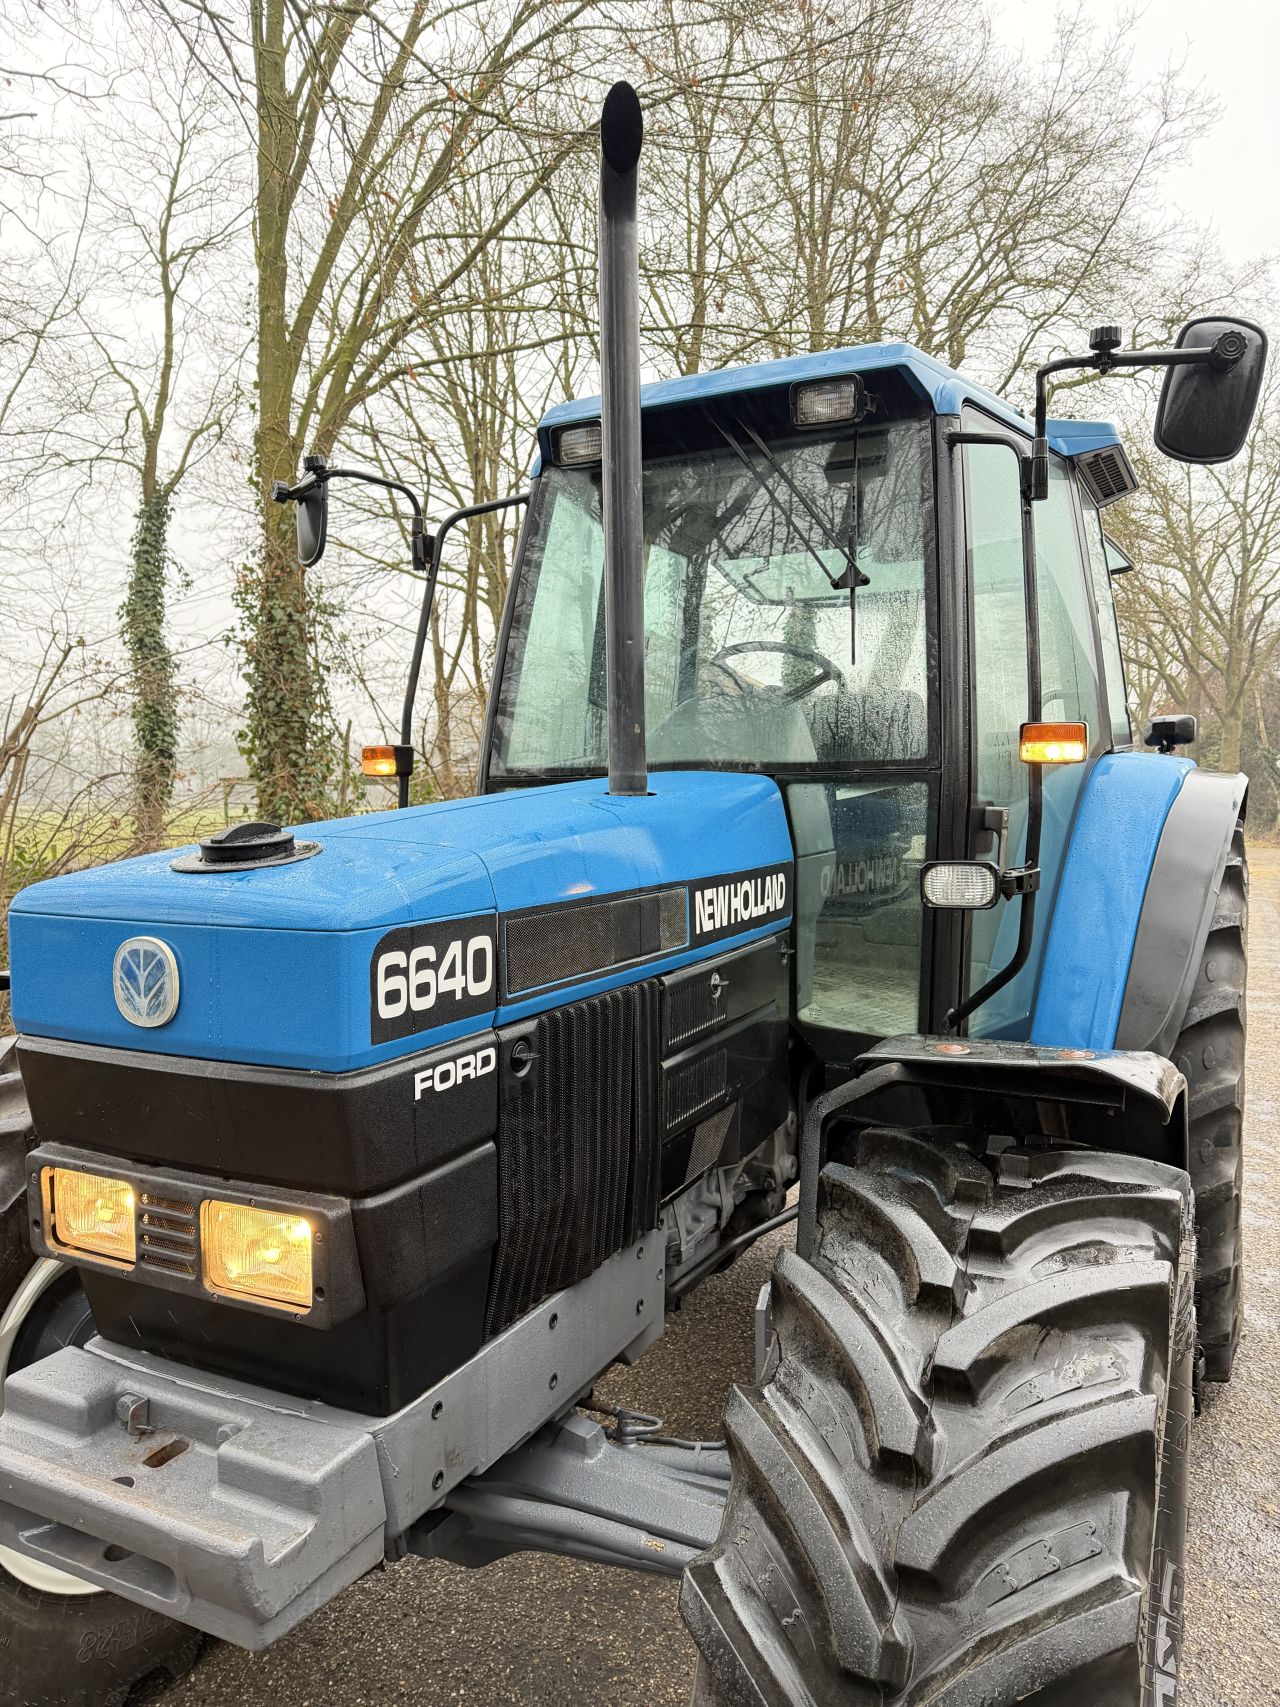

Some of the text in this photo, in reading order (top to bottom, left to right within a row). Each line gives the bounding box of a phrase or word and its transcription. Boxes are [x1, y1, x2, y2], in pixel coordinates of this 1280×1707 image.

[695, 872, 786, 934] NEW HOLLAND
[377, 935, 493, 1020] 6640
[414, 1047, 496, 1101] FORD
